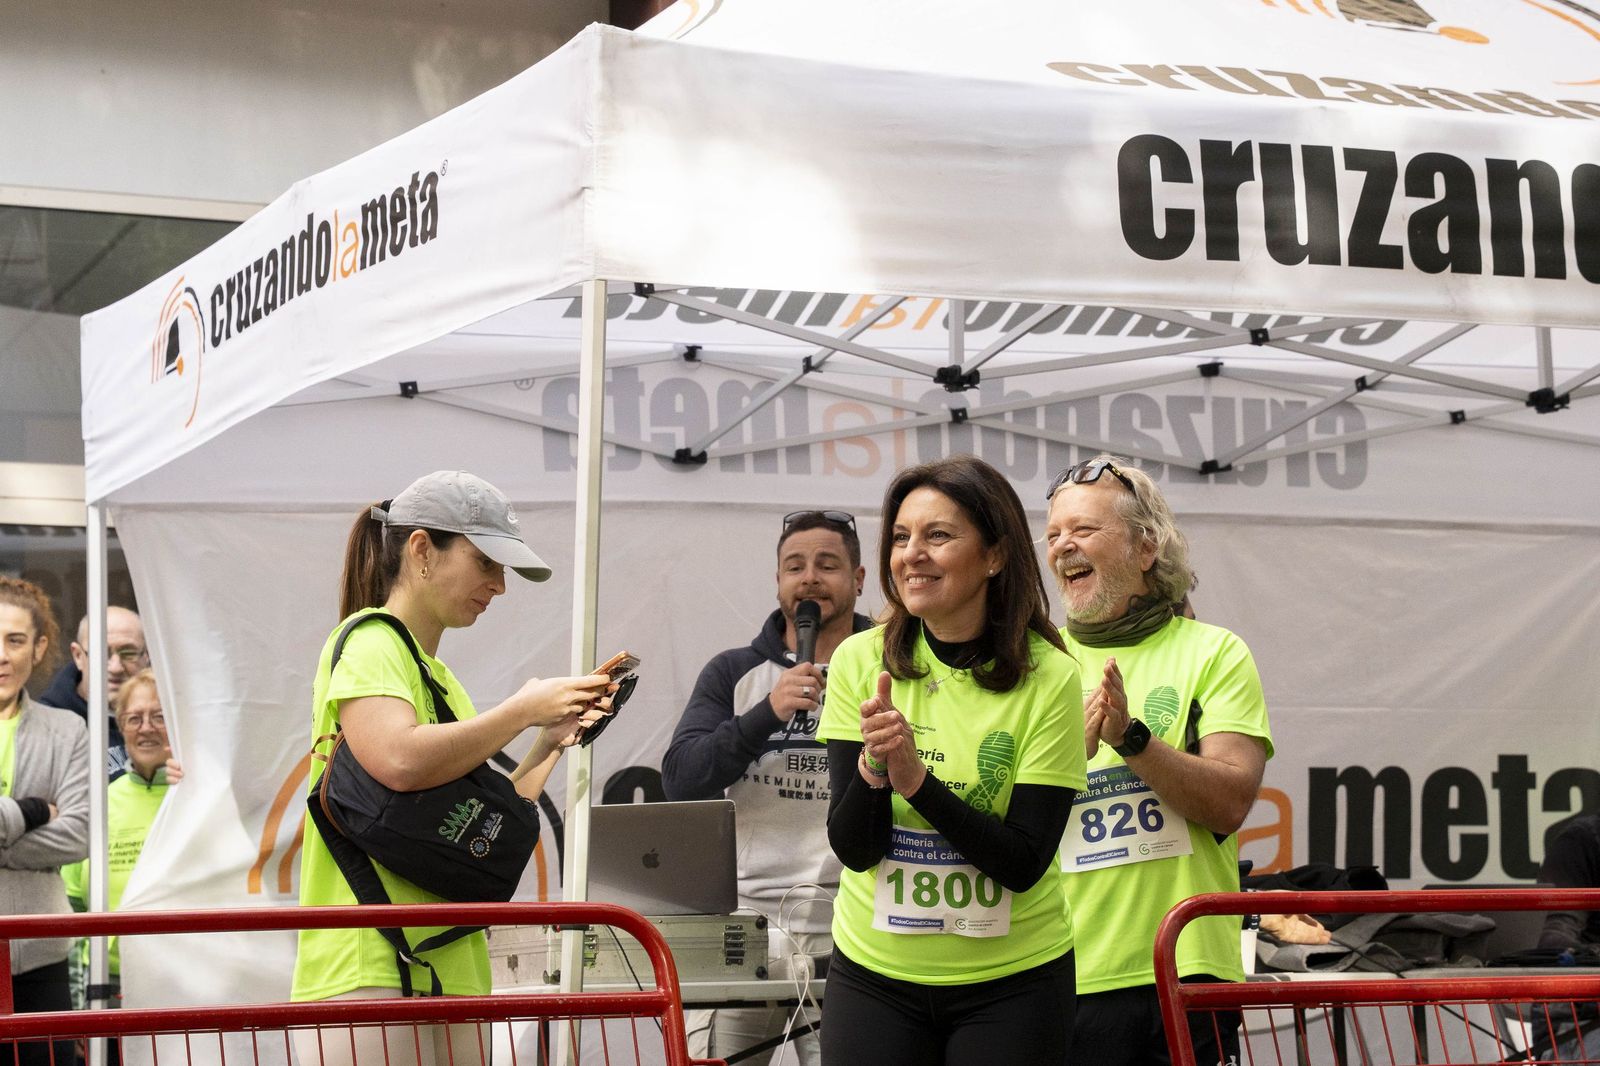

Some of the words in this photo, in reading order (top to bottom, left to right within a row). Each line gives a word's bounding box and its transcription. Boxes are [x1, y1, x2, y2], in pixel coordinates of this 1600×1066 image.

[916, 748, 945, 763] ería
[1074, 788, 1101, 801] ontra
[1103, 784, 1113, 794] el
[1115, 780, 1147, 792] cánce
[1080, 798, 1164, 843] 826
[893, 848, 924, 860] contra
[926, 850, 937, 860] el
[940, 850, 966, 860] cánc
[886, 867, 1003, 909] 1800
